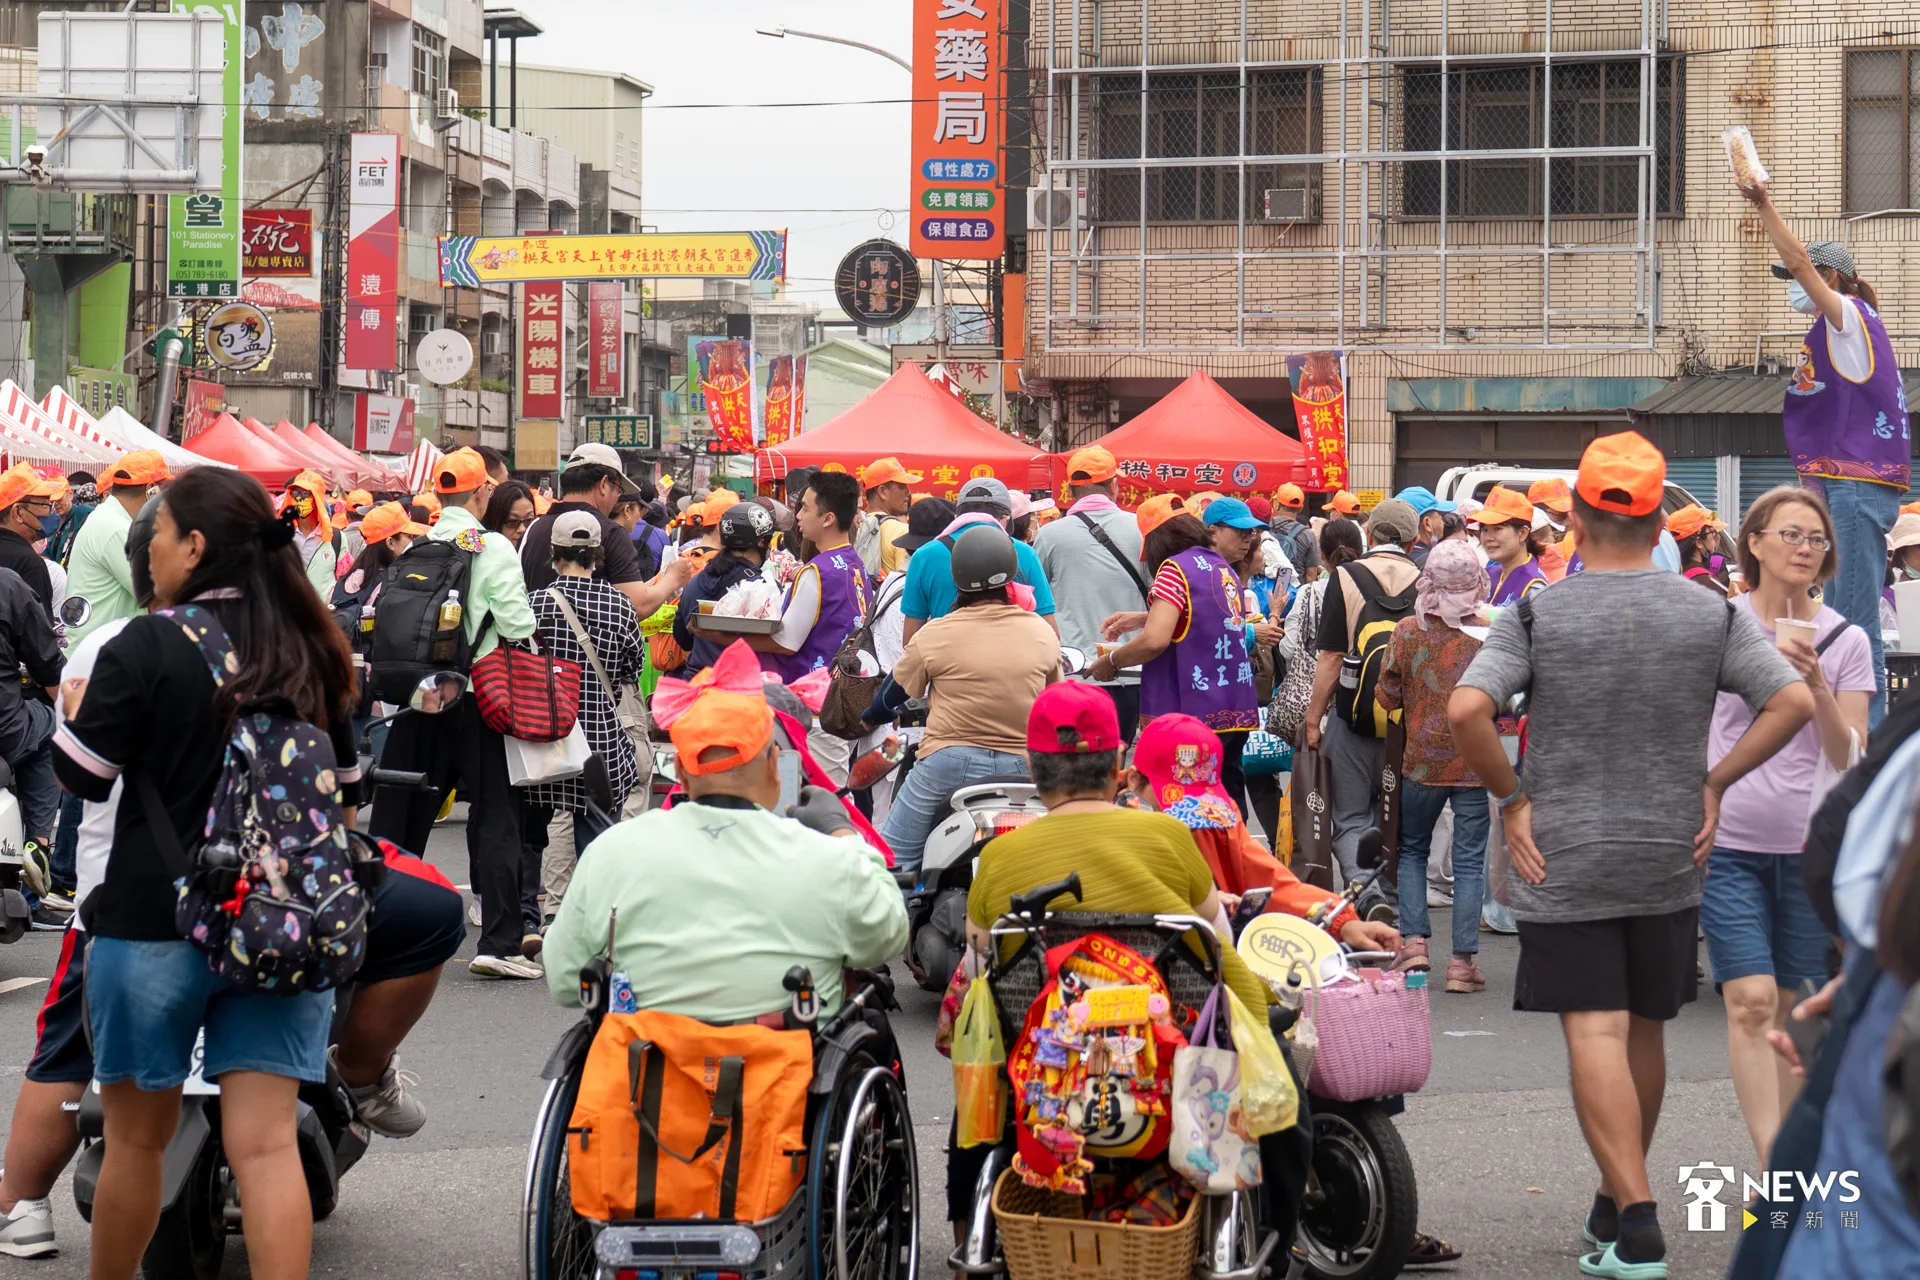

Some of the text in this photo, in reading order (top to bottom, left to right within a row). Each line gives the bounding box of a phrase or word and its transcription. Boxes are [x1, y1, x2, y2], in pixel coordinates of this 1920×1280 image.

[359, 167, 387, 177] FET
[929, 162, 989, 178] 慢性處方
[928, 192, 988, 207] 免費領藥
[190, 231, 235, 240] Stationery
[928, 222, 988, 238] 保健食品
[183, 241, 222, 249] Paradise
[522, 240, 549, 249] 恭迎
[174, 282, 231, 296] 北港店
[360, 274, 381, 330] 遠傳
[528, 293, 557, 395] 光陽機車
[283, 371, 312, 380] 西螺大橋
[1312, 406, 1343, 488] 拱和堂
[1120, 460, 1223, 485] 拱和堂
[1238, 467, 1251, 484] 東
